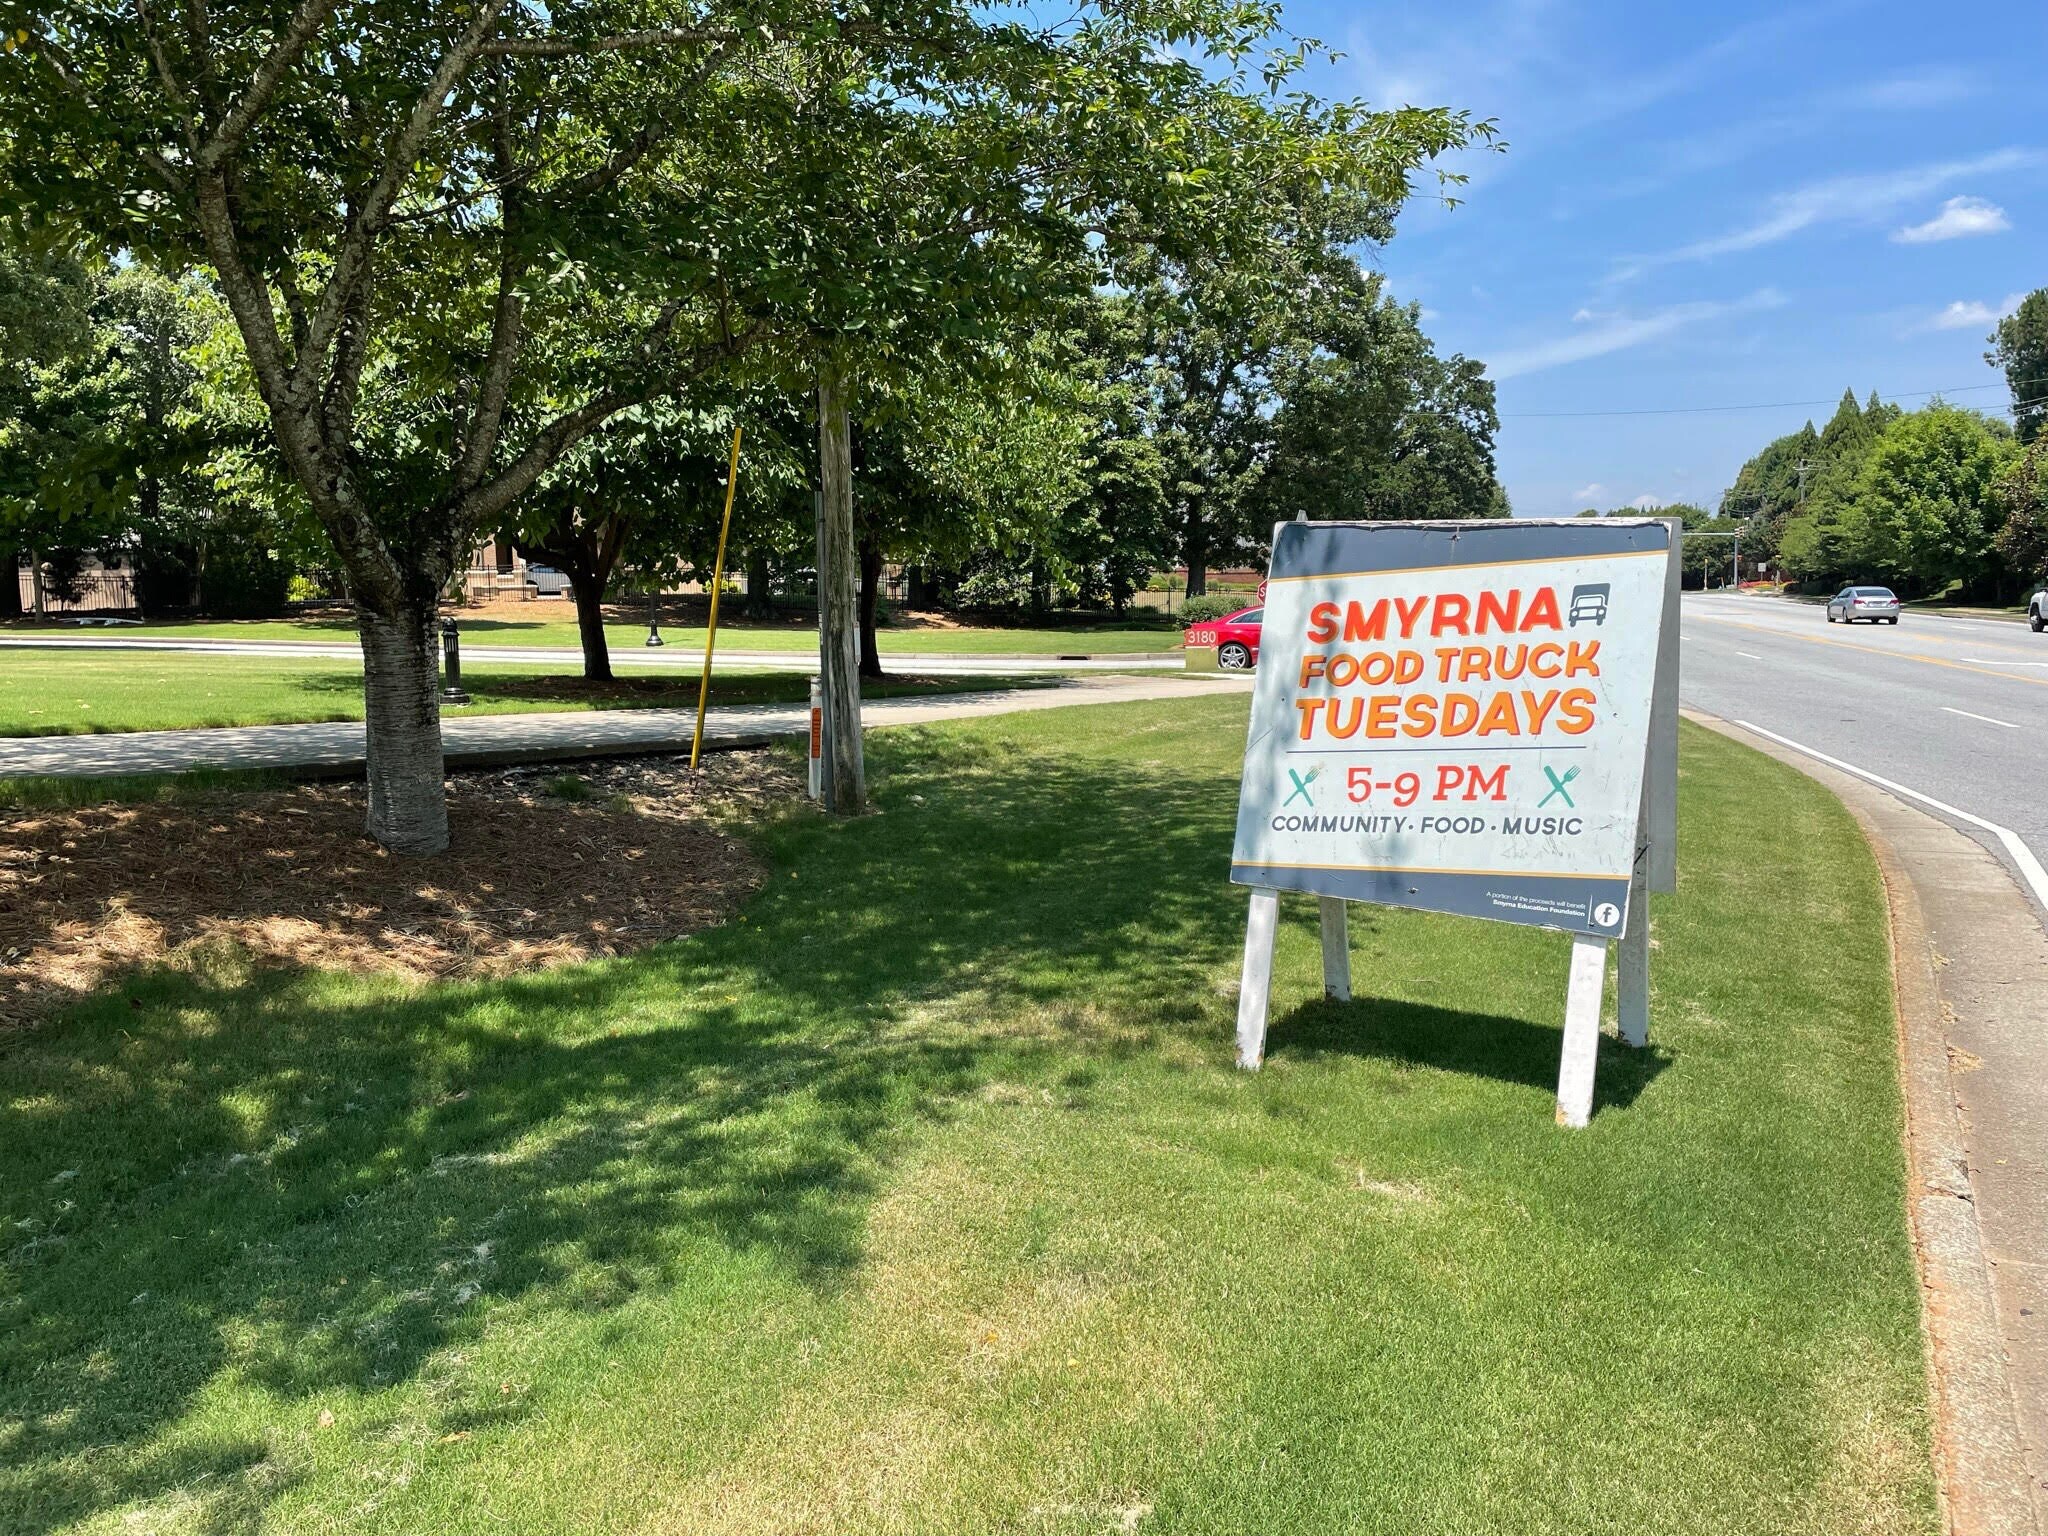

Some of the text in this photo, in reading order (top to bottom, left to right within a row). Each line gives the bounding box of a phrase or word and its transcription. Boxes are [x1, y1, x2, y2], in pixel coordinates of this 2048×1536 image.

[1308, 587, 1563, 644] SMYRNA
[1188, 630, 1216, 643] 3180
[1299, 640, 1602, 688] FOOD TRUCK
[1296, 688, 1597, 740] TUESDAYS
[1346, 765, 1511, 807] 5-9 PM
[1421, 816, 1485, 834] FOOD
[1502, 817, 1583, 835] MUSIC
[1493, 899, 1585, 916] Smyrna Education Foundation
[1529, 898, 1555, 906] proceeds
[1566, 902, 1586, 910] benefit
